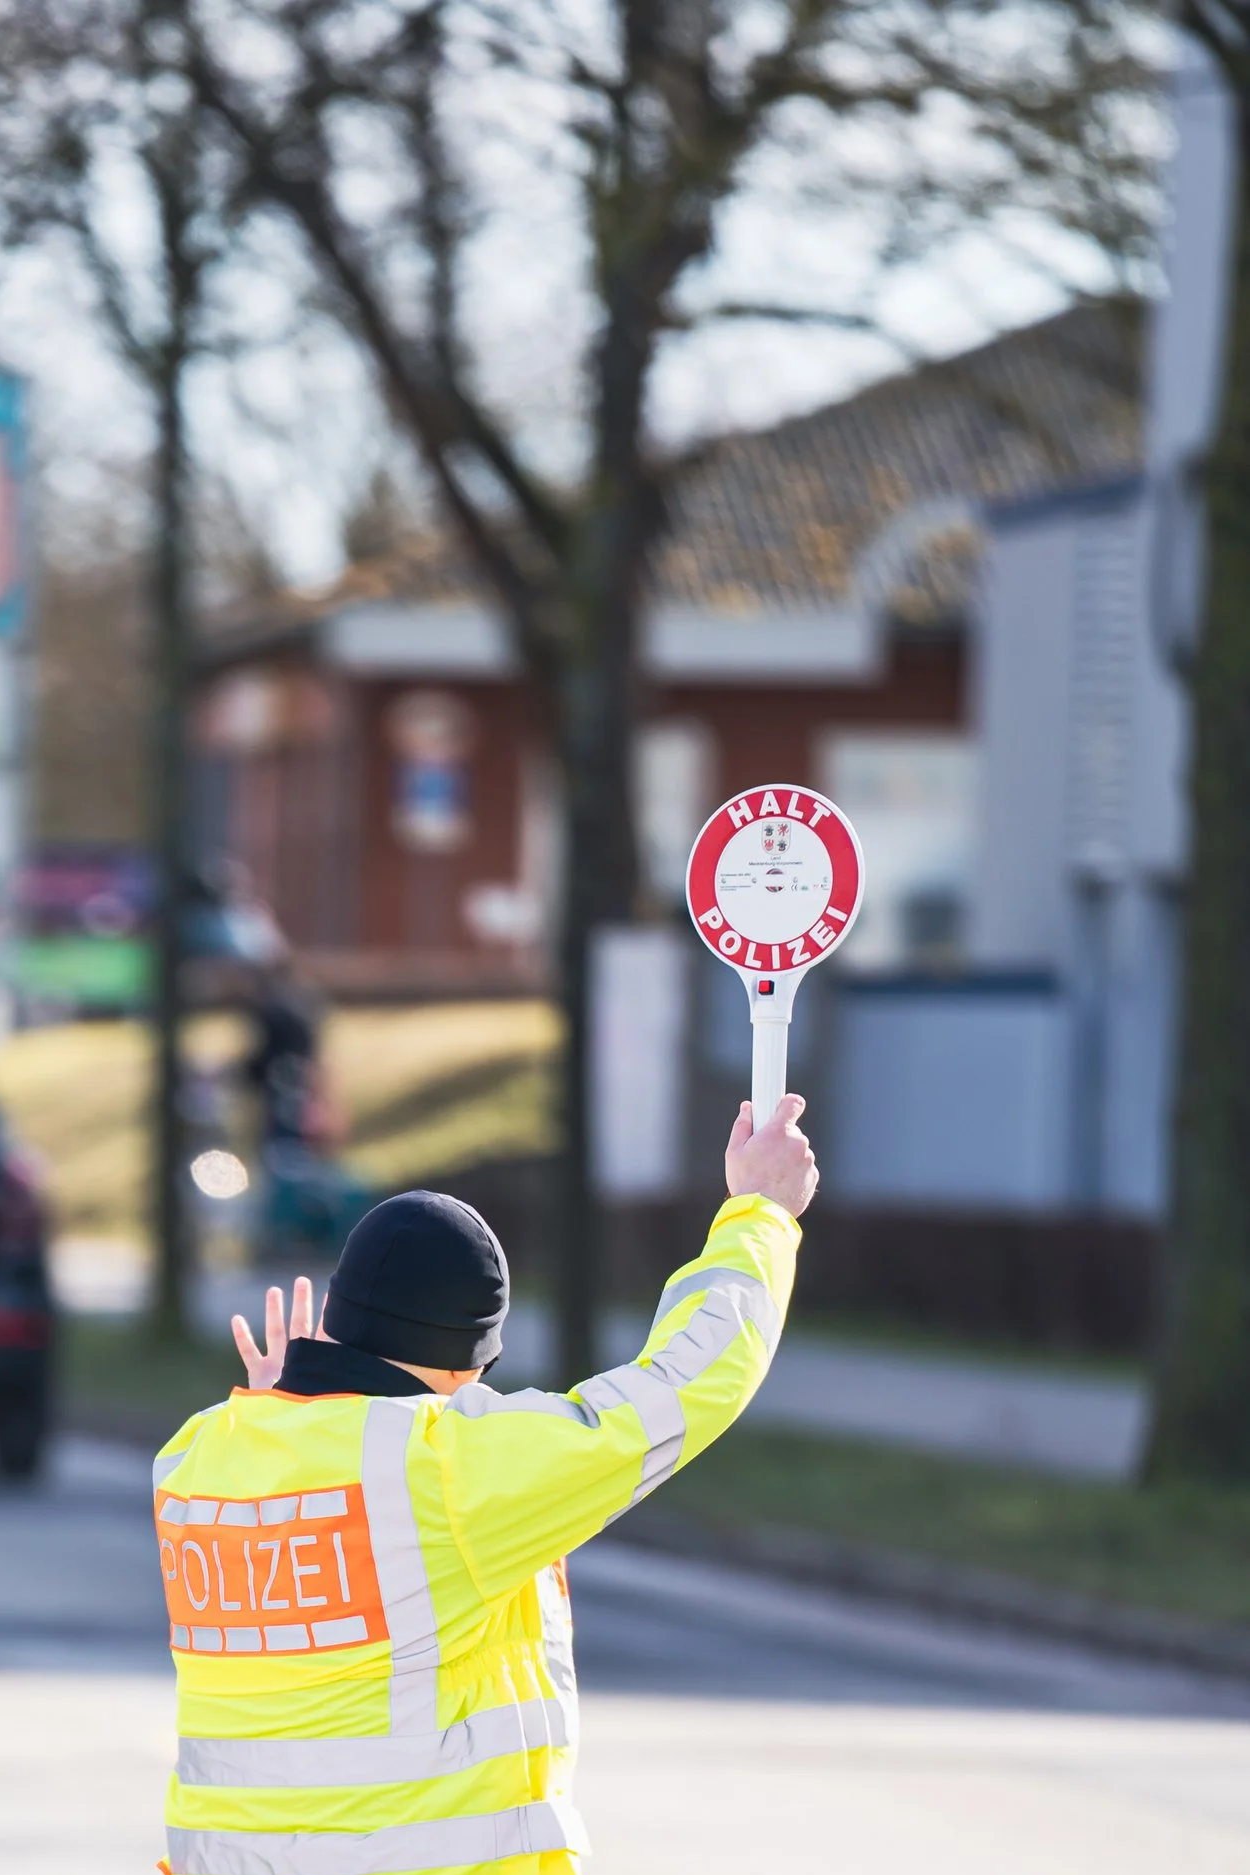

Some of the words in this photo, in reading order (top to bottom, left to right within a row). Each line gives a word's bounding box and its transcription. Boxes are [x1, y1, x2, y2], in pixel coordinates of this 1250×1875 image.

[727, 791, 831, 829] HALT
[698, 905, 848, 969] POLIZEI
[160, 1531, 351, 1612] POLIZEI
